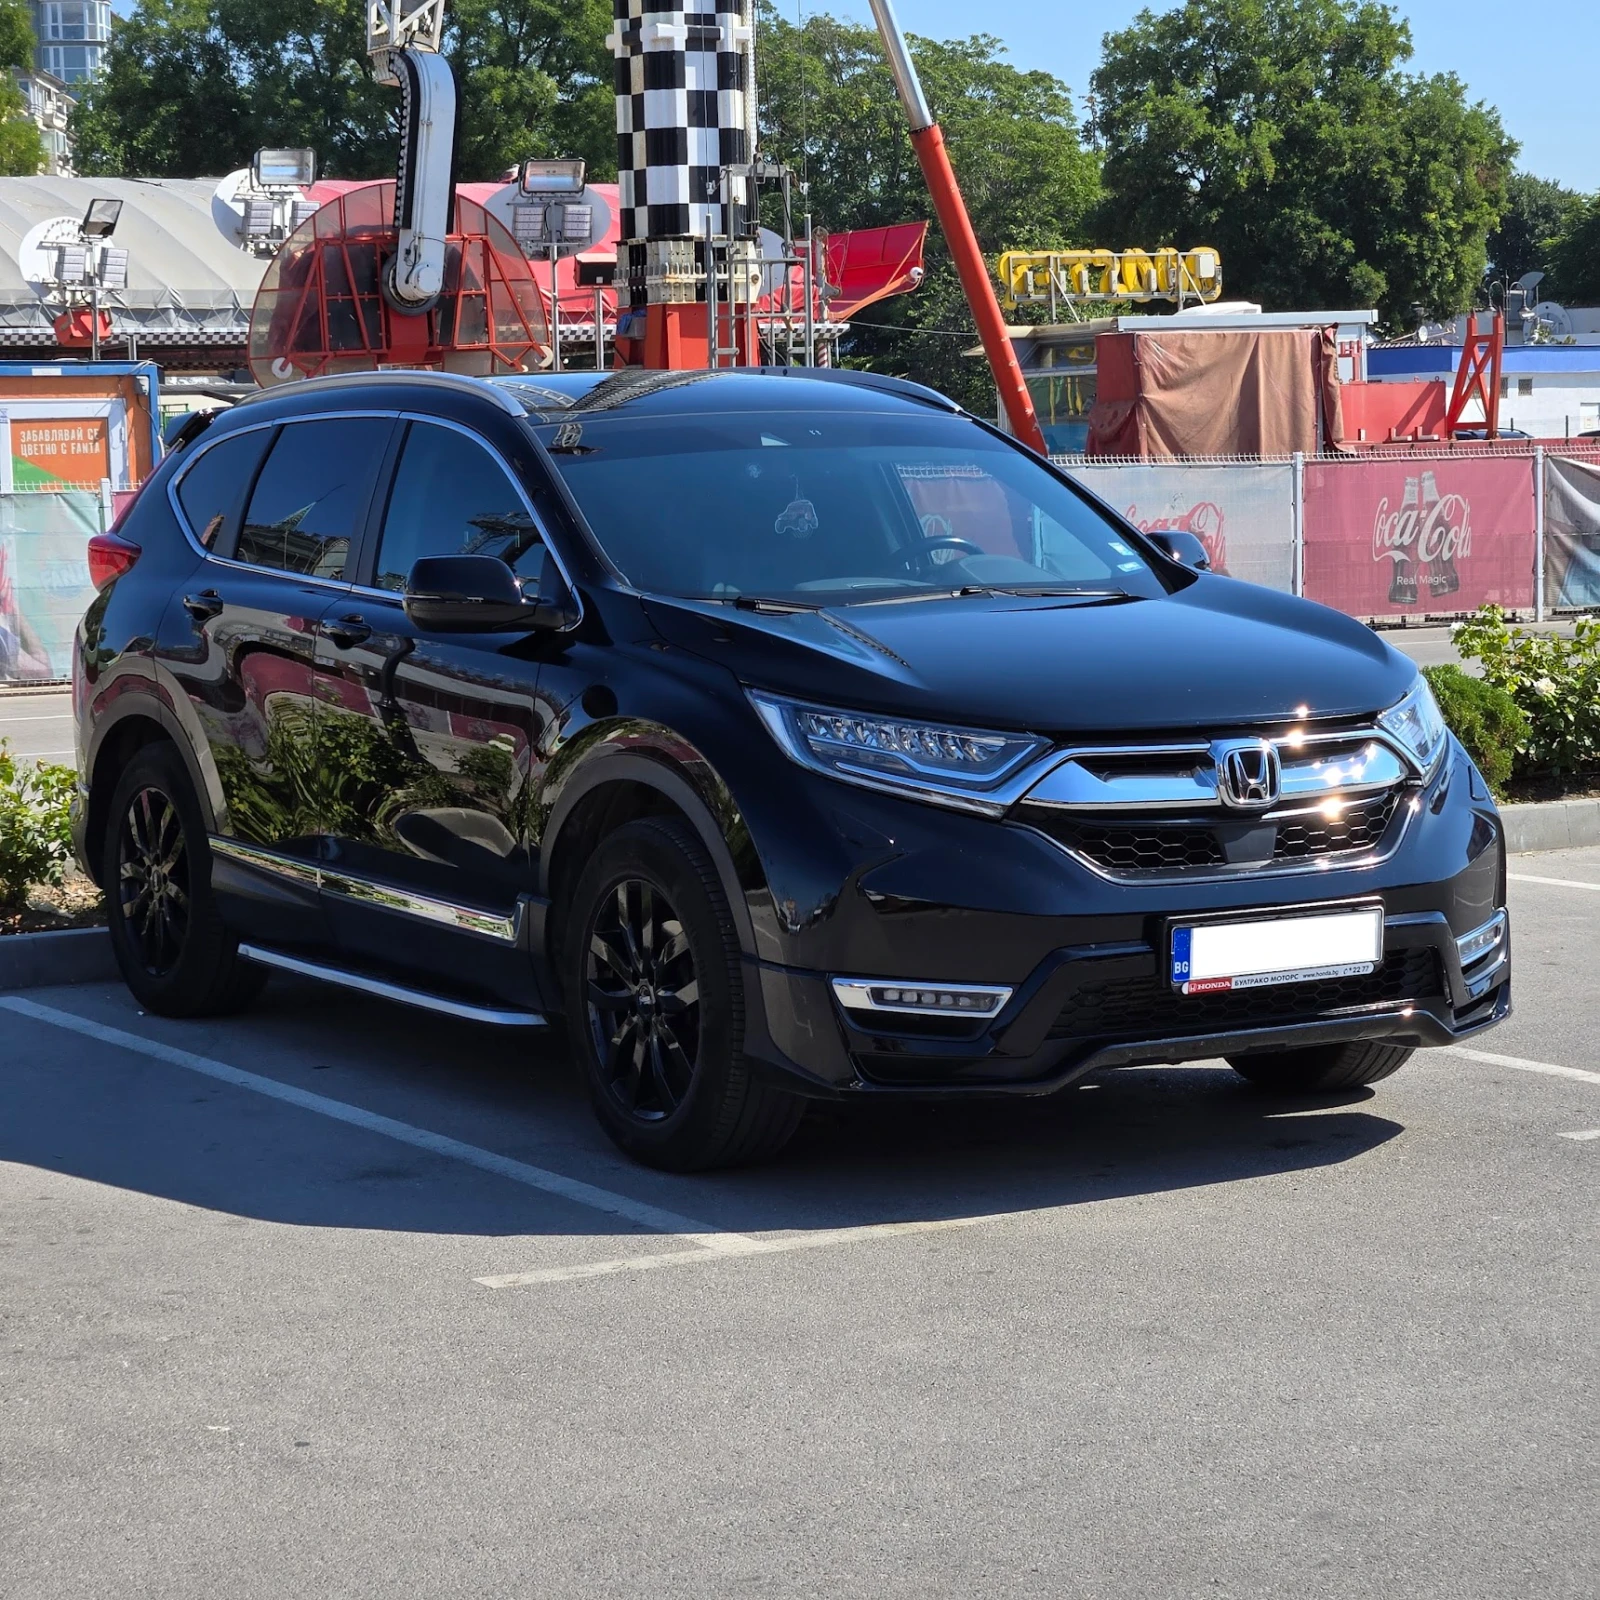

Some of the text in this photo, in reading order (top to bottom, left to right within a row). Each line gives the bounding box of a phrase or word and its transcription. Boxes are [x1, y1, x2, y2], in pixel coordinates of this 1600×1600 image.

[20, 427, 100, 443] ЗАБАВЛЯВАЙ СЕ
[20, 443, 57, 457] ЦВЕТНО
[71, 442, 100, 455] FANTA
[1372, 493, 1472, 563] Coca-Cola
[1125, 502, 1226, 569] -Cola
[1396, 574, 1447, 586] Real Magic
[1174, 961, 1189, 974] BG
[1302, 969, 1339, 978] www.honda.bg
[1197, 981, 1231, 990] HONDA
[1234, 973, 1299, 987] БУЛТРАКО МОТОРС
